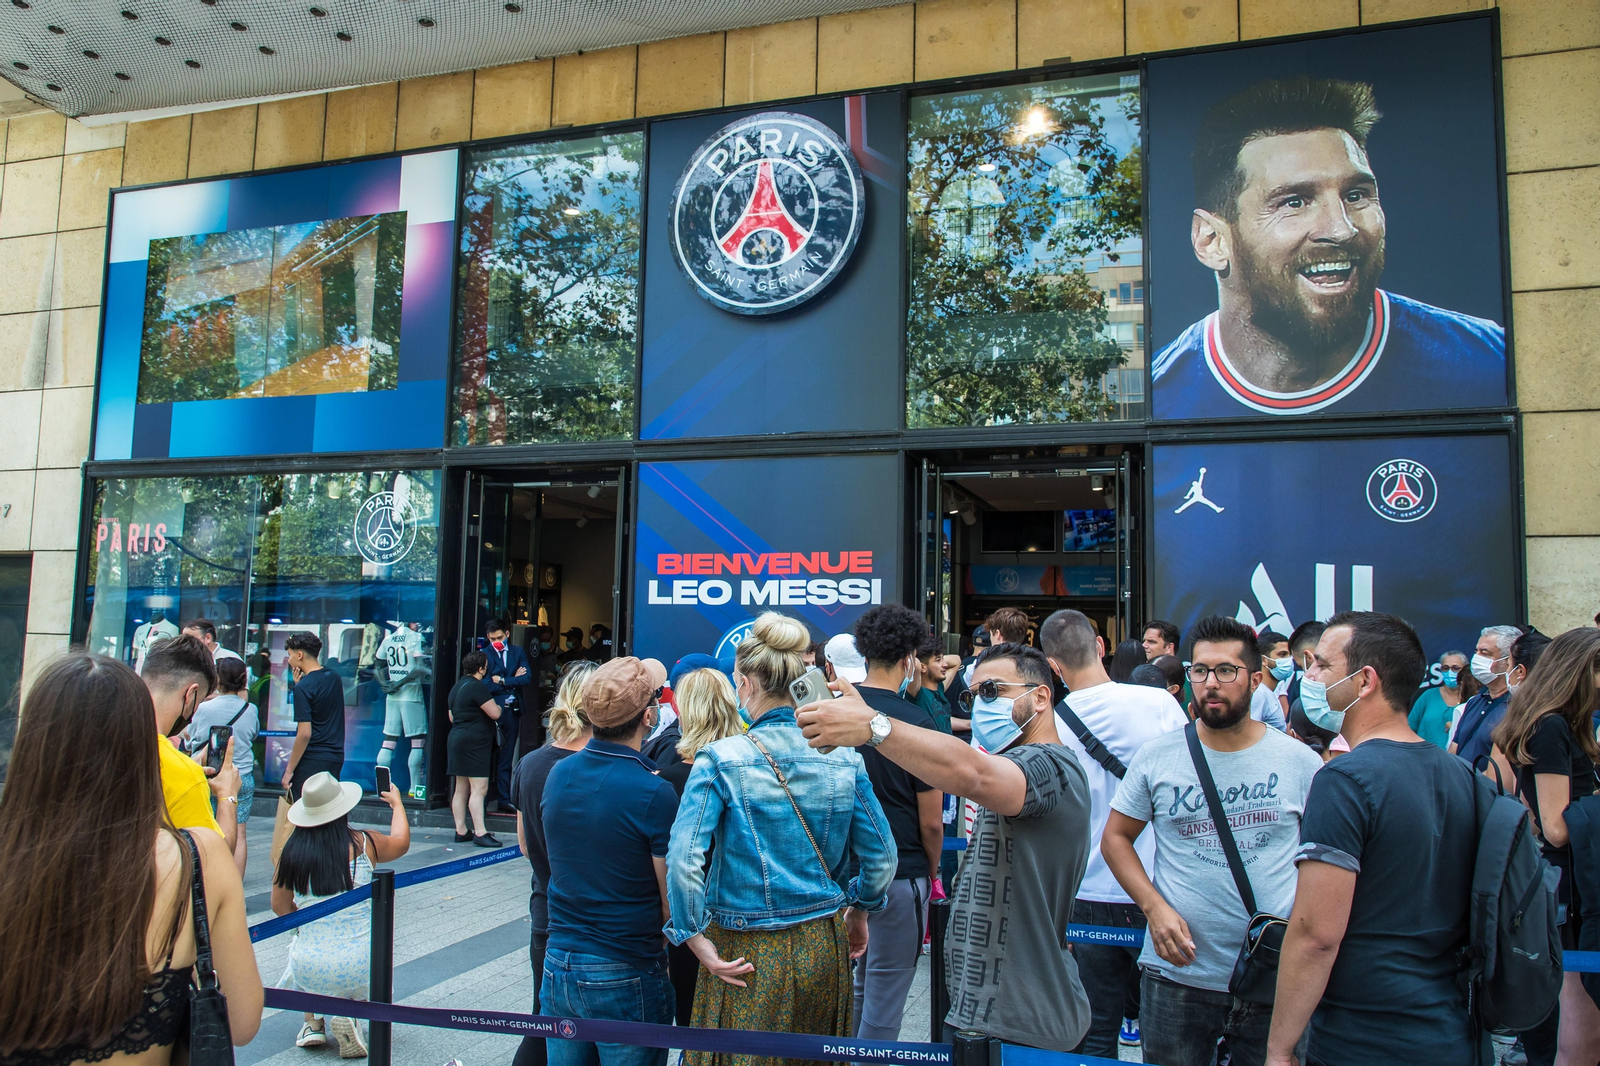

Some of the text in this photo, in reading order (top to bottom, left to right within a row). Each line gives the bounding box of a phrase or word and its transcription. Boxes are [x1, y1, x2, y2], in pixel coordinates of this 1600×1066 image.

[706, 128, 824, 176] PARIS
[1377, 462, 1425, 478] PARIS
[95, 523, 167, 552] PARIS
[657, 551, 873, 575] BIENVENUE
[648, 578, 882, 606] LEO MESSI
[387, 646, 409, 667] 30
[469, 849, 516, 867] PARIS SAINT-GERMAIN
[1192, 849, 1230, 869] SANFORIZE
[451, 1015, 553, 1031] PARIS SAINT-GERMAIN
[823, 1044, 949, 1063] PARIS SAINT-GERMAIN
